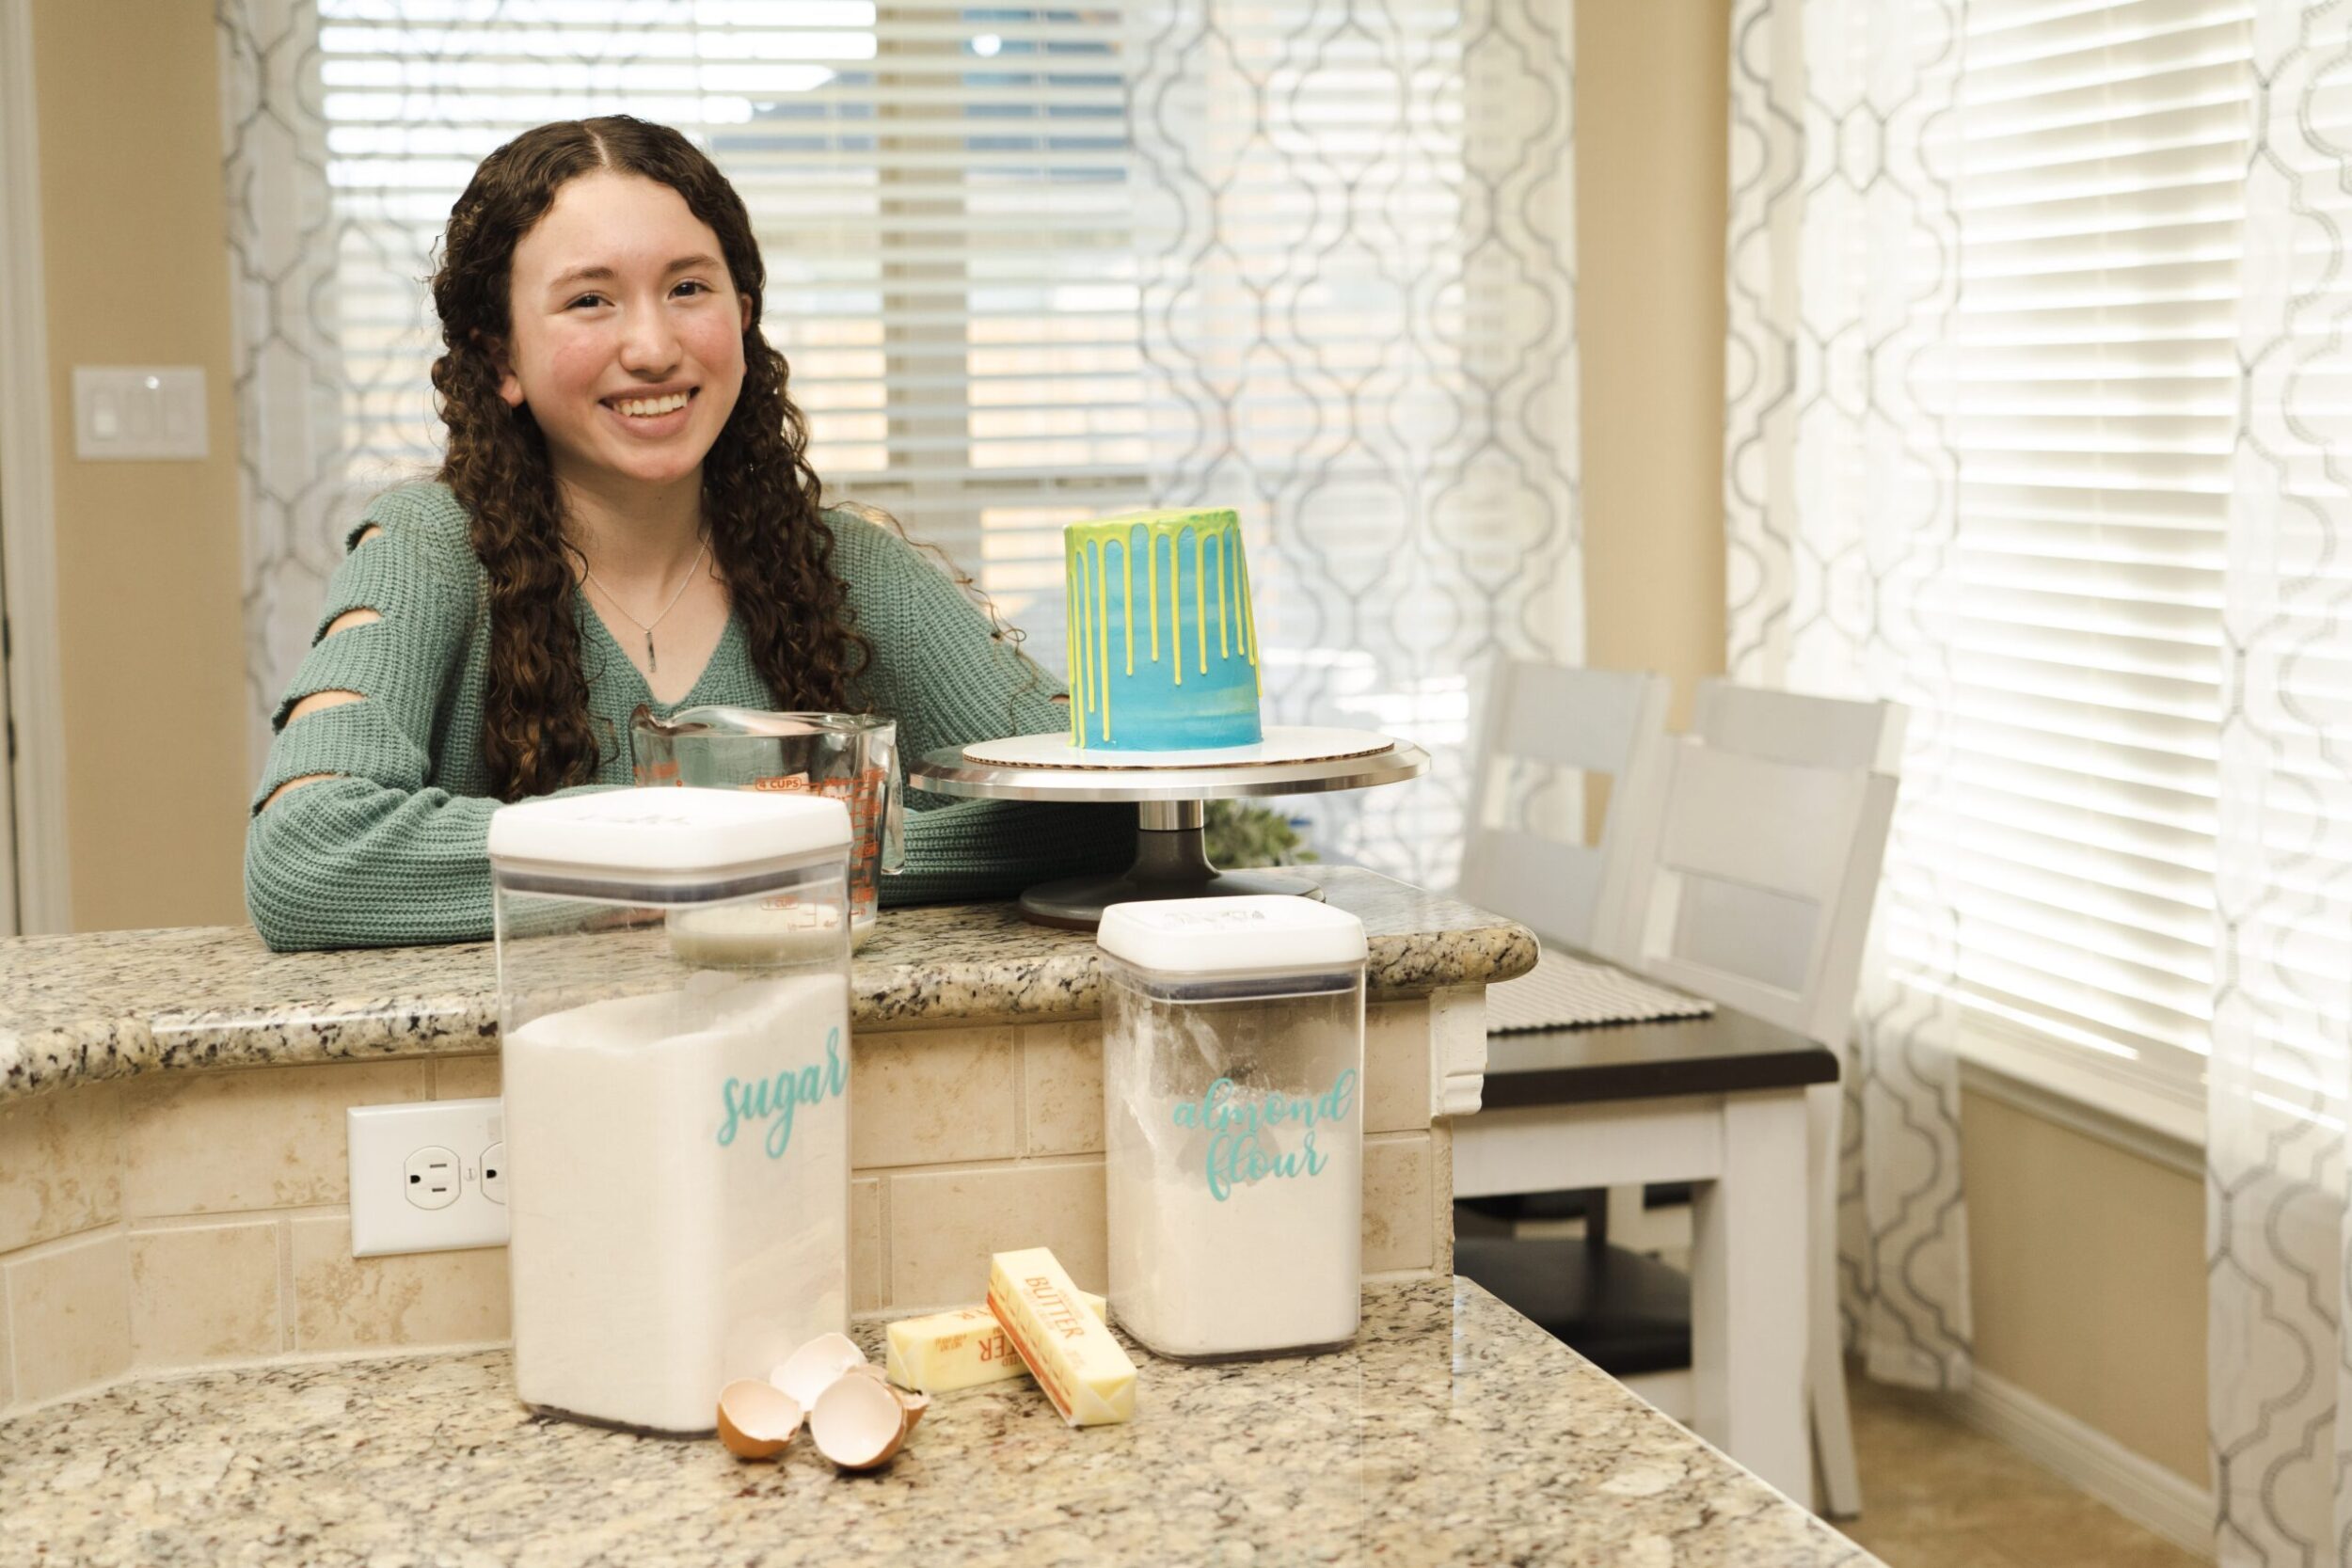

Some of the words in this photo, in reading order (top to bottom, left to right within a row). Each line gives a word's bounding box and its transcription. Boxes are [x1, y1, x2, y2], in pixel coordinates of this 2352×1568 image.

[757, 779, 767, 789] 4
[770, 779, 799, 789] CUPS
[717, 1026, 849, 1159] sugar
[1173, 1069, 1357, 1132] almond
[1207, 1131, 1327, 1201] flour
[1025, 1276, 1085, 1339] BUTTER
